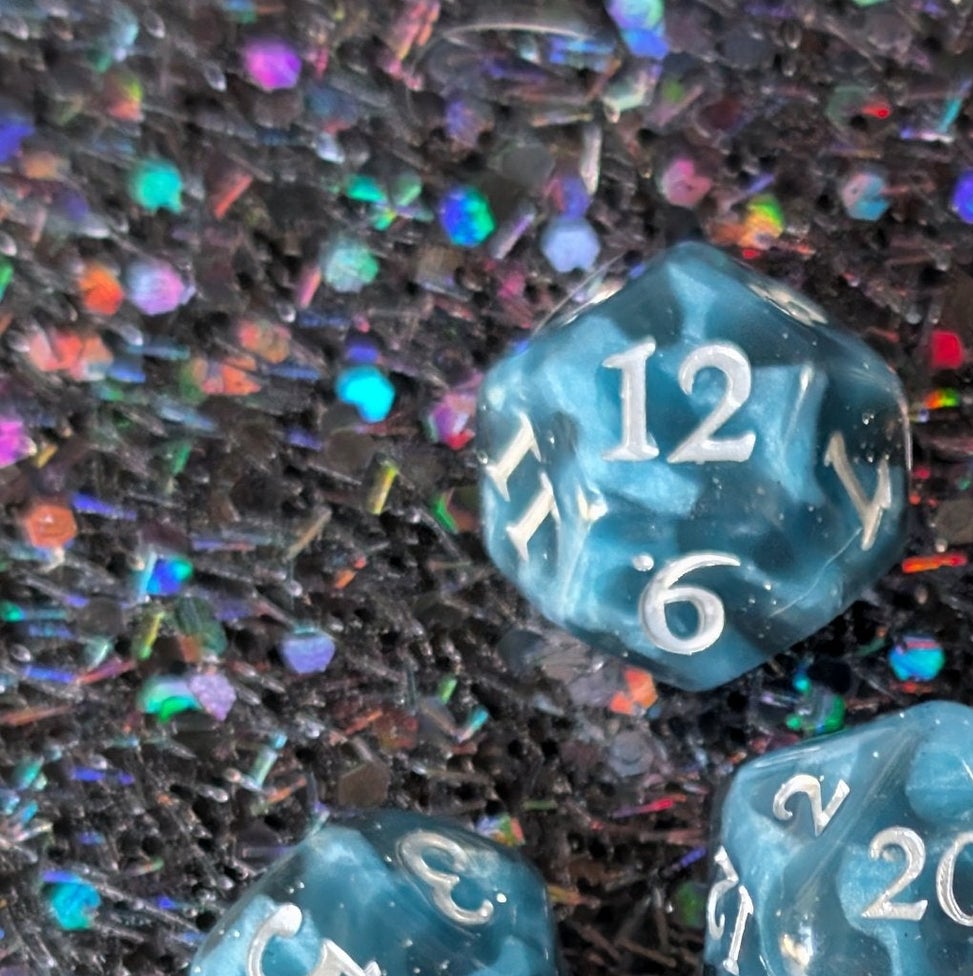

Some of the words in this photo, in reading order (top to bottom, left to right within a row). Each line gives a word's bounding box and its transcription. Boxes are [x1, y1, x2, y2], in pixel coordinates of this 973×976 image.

[600, 337, 757, 463] 12
[773, 774, 850, 836] 2
[400, 829, 493, 925] 3
